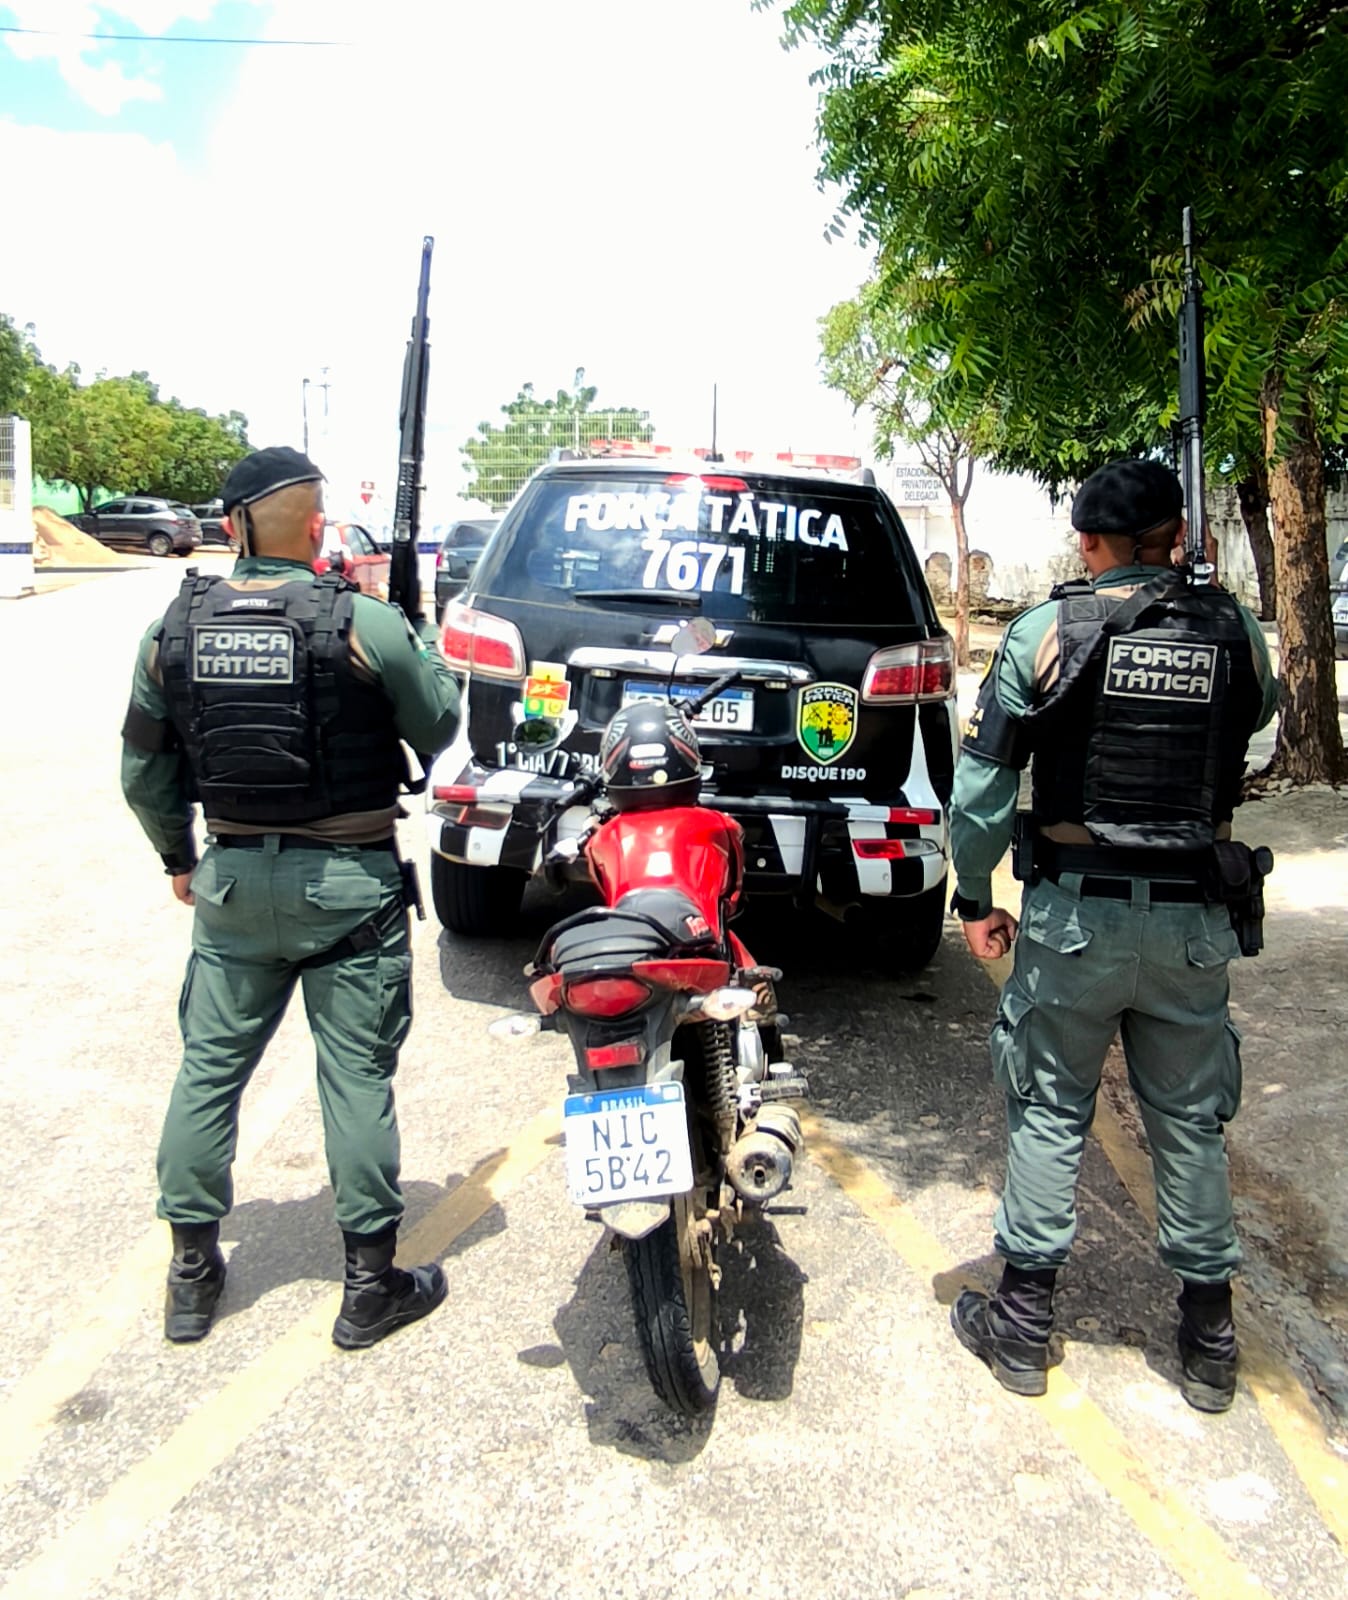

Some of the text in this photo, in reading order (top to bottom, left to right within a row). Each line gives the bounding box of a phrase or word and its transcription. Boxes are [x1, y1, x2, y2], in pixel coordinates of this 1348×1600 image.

[901, 479, 933, 490] PRIVATIVO
[904, 490, 939, 501] DELEGACIA
[564, 492, 849, 552] FORÇA TÁTICA
[641, 539, 746, 595] 7671
[198, 632, 290, 652] FORÇA
[198, 652, 290, 676] TÁTICA
[1112, 644, 1211, 670] FORÇA
[1111, 667, 1210, 694] TÁTICA
[781, 765, 867, 782] DISQUE 190
[601, 1096, 646, 1112] BRASIL
[592, 1111, 658, 1152] NIC
[585, 1149, 673, 1193] 5B42
